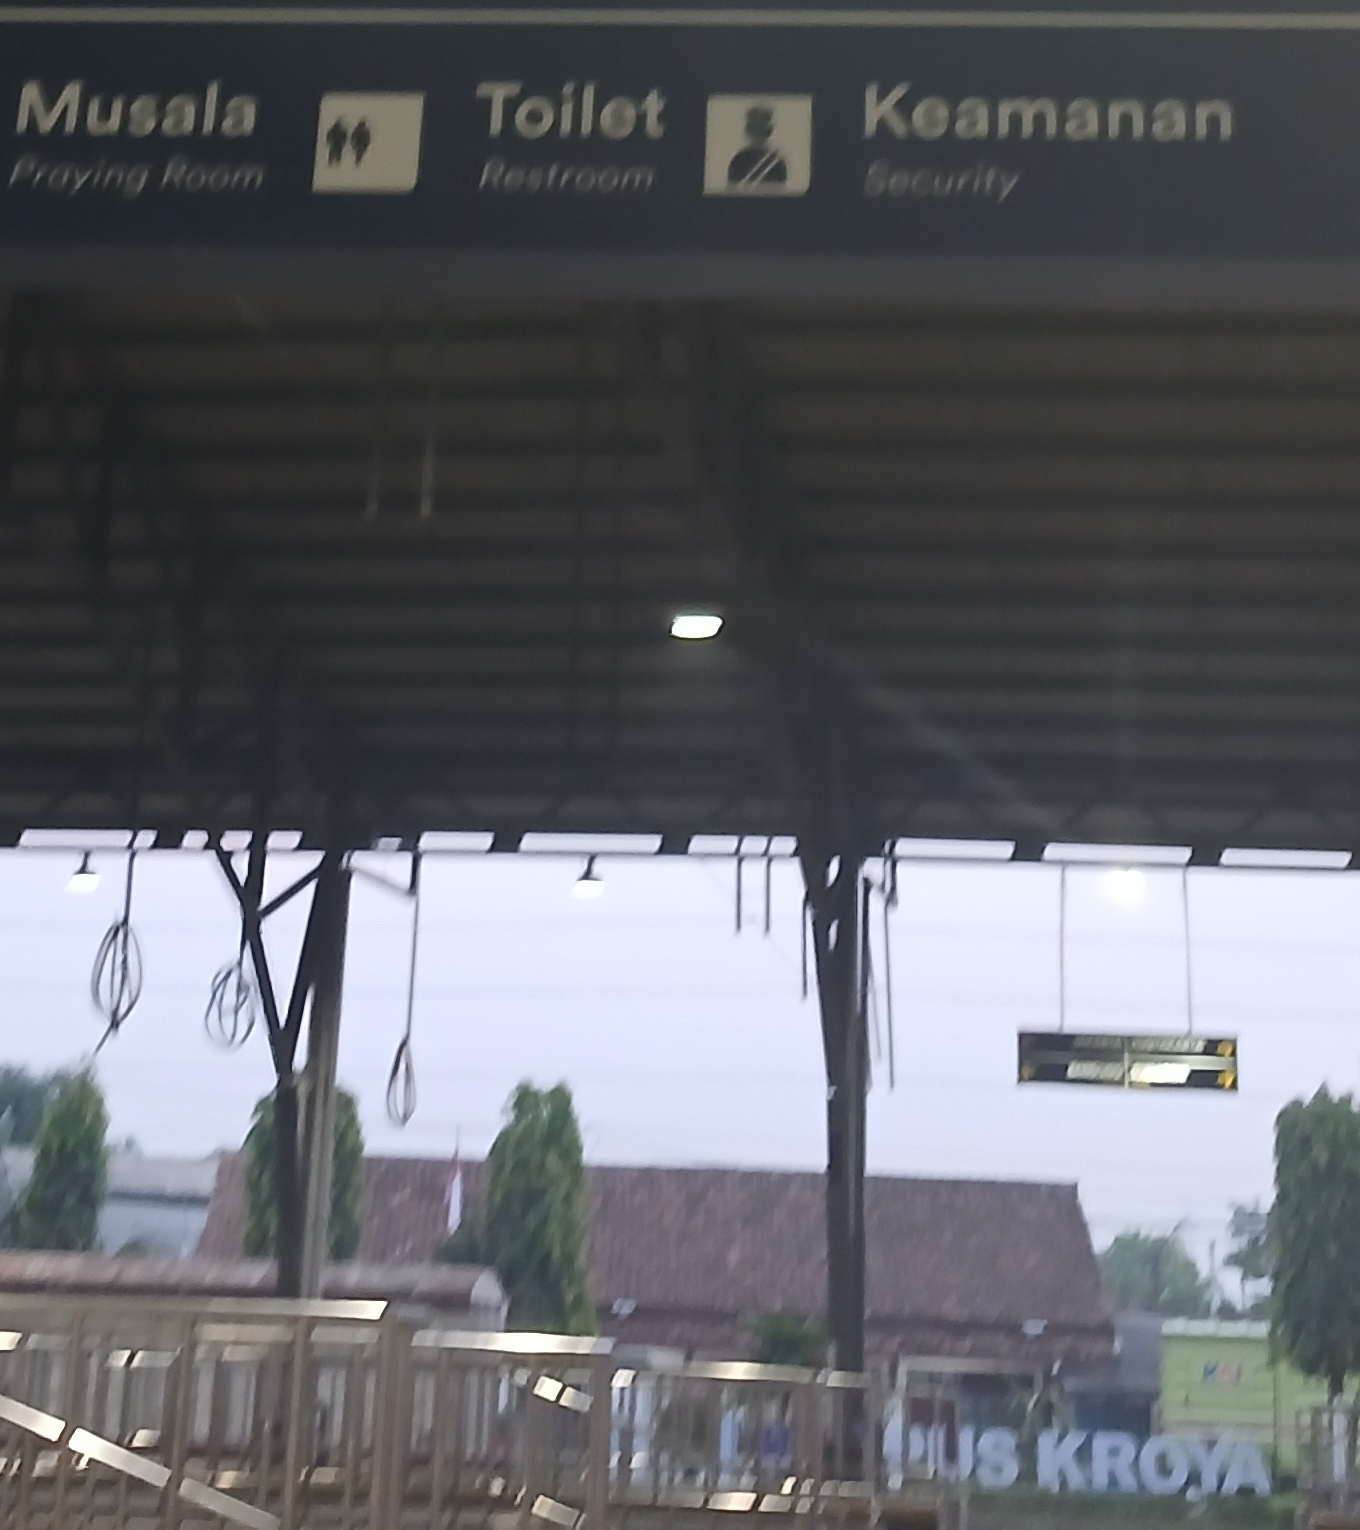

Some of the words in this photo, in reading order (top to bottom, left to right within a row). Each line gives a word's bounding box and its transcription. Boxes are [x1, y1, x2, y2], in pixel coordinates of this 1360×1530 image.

[15, 79, 257, 137] Musala
[476, 80, 666, 140] Toilet
[863, 80, 1234, 141] Keamanan
[8, 154, 150, 199] Praying
[160, 154, 266, 191] Room
[478, 156, 654, 193] Restroom
[862, 158, 1021, 203] Security
[1037, 1427, 1272, 1497] KROYA
